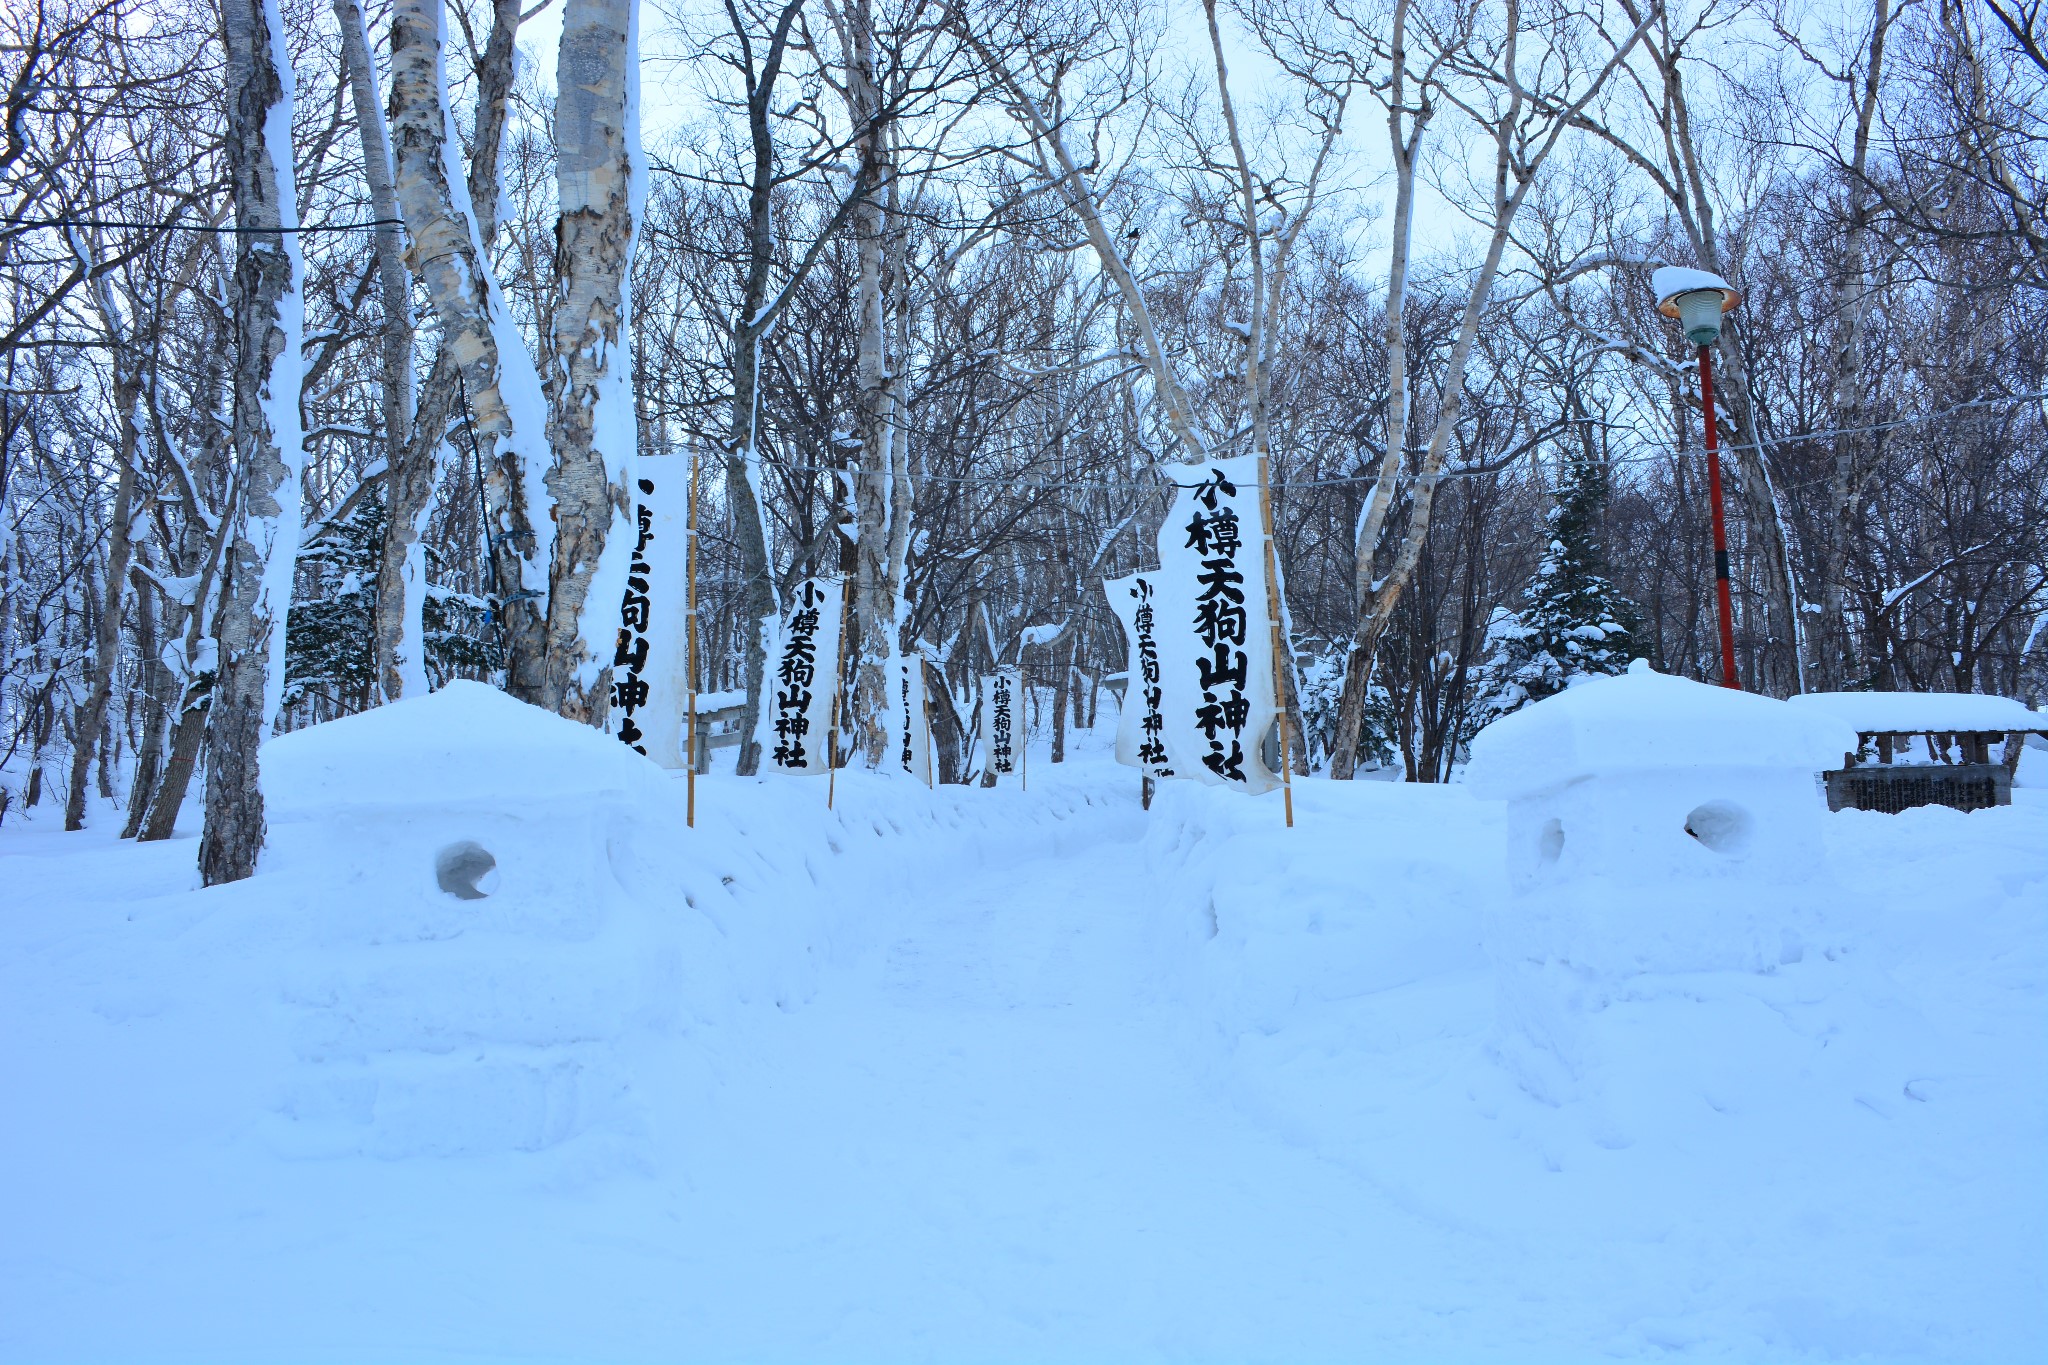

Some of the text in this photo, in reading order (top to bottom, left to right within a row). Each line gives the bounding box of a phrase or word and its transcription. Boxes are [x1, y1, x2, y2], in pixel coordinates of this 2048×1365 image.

[772, 580, 825, 769] 小樽天狗山神社
[1184, 468, 1250, 783] 小樽天狗山神社
[991, 675, 1013, 773] 小樽天狗山神社
